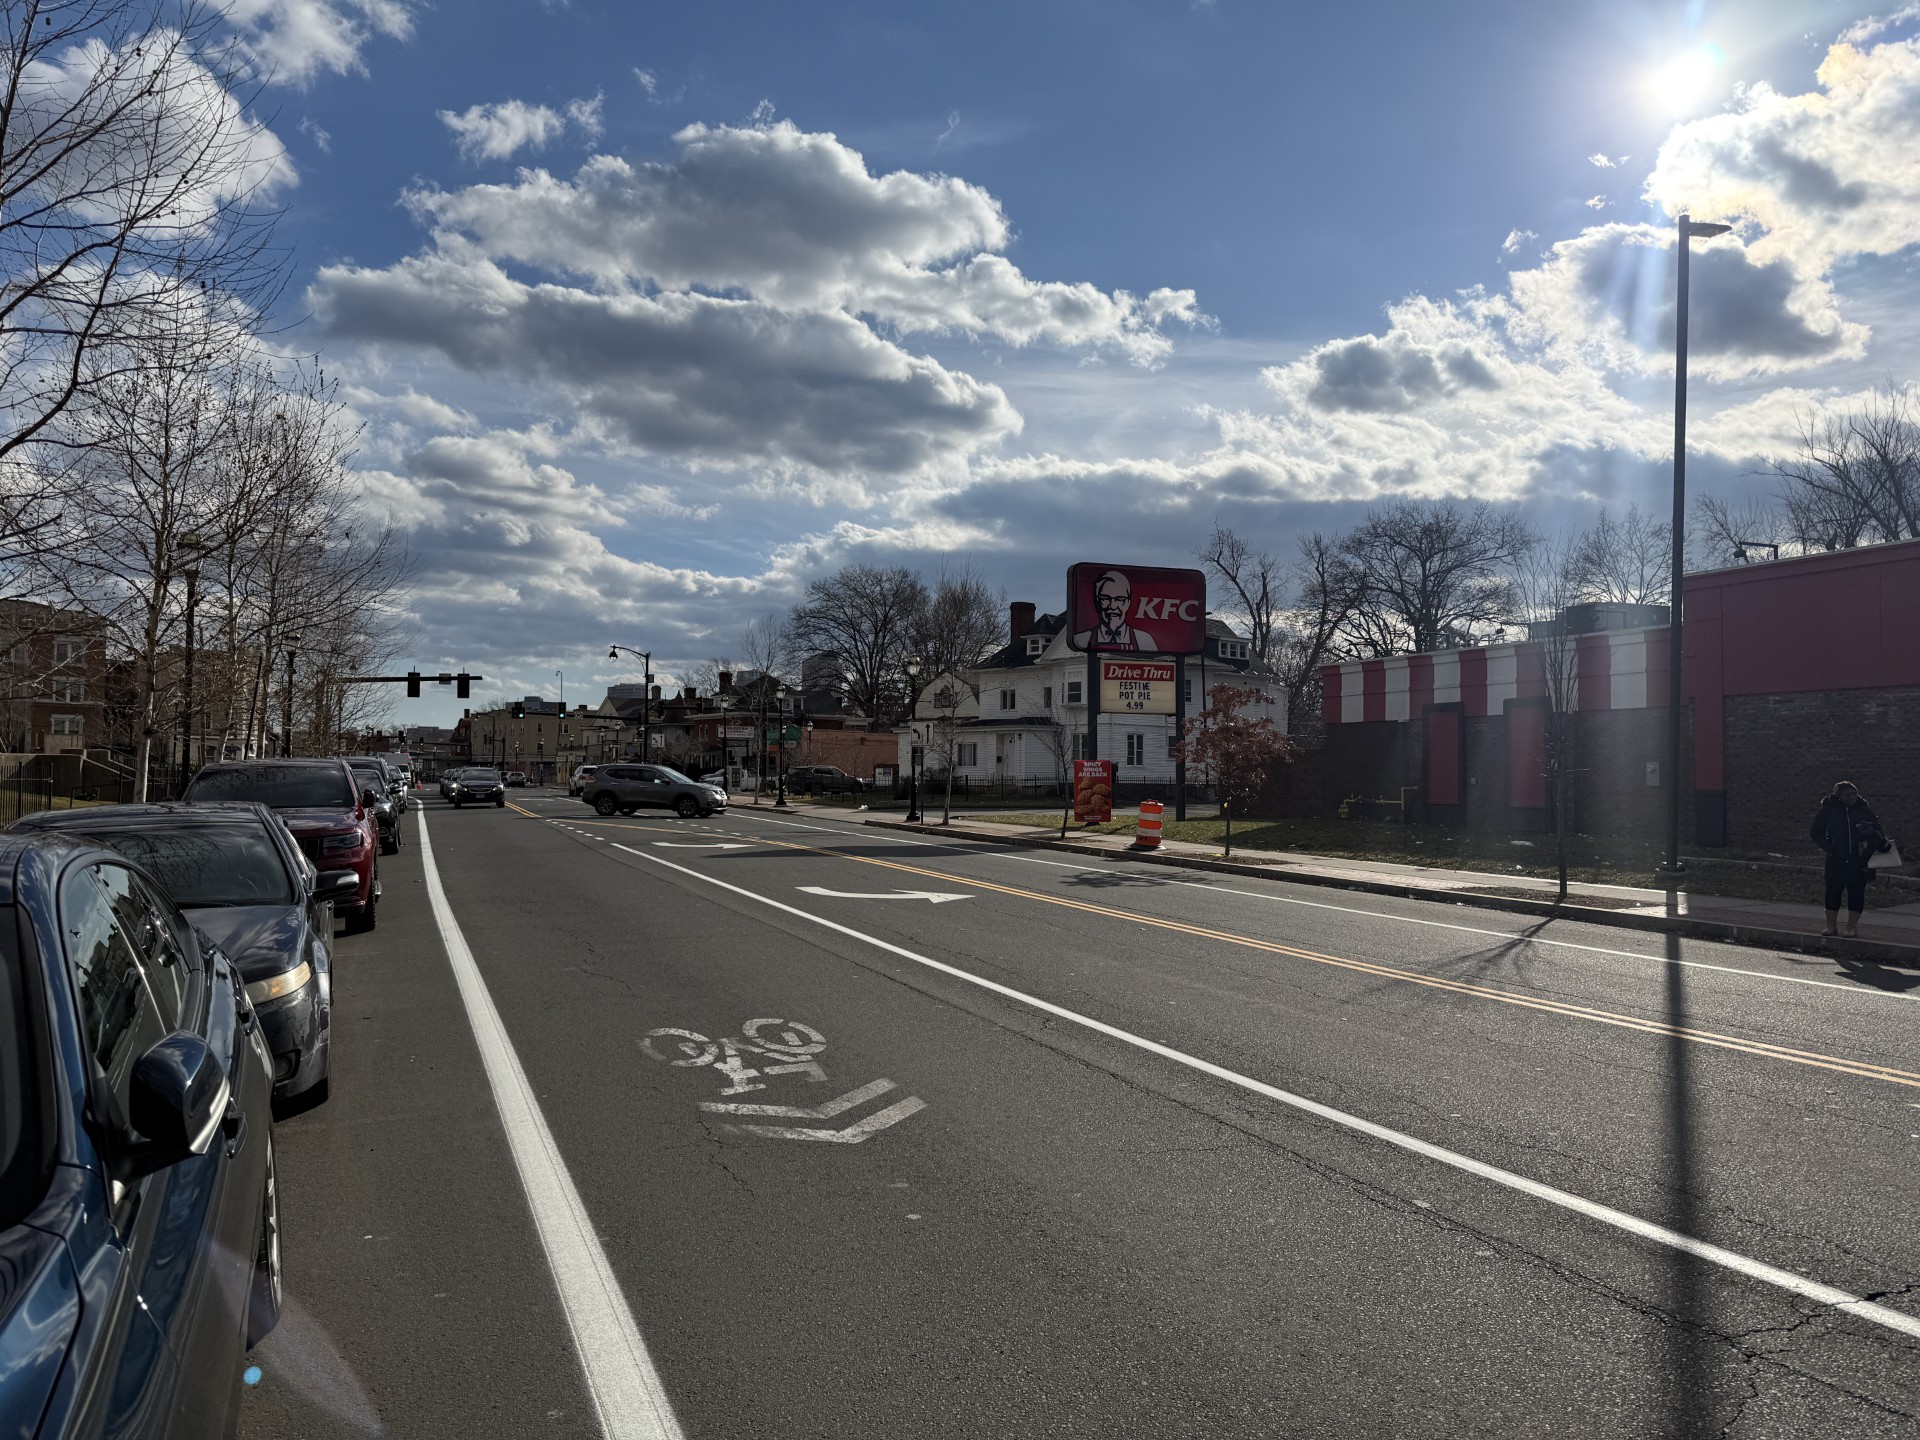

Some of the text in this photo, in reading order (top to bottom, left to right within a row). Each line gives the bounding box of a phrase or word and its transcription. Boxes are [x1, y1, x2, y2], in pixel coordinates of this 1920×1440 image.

[1134, 596, 1200, 622] KFC
[1107, 665, 1171, 679] Drive Thru
[1119, 681, 1150, 690] FESTIVE
[1119, 691, 1151, 700] POT PIE
[1126, 701, 1144, 710] 4.99
